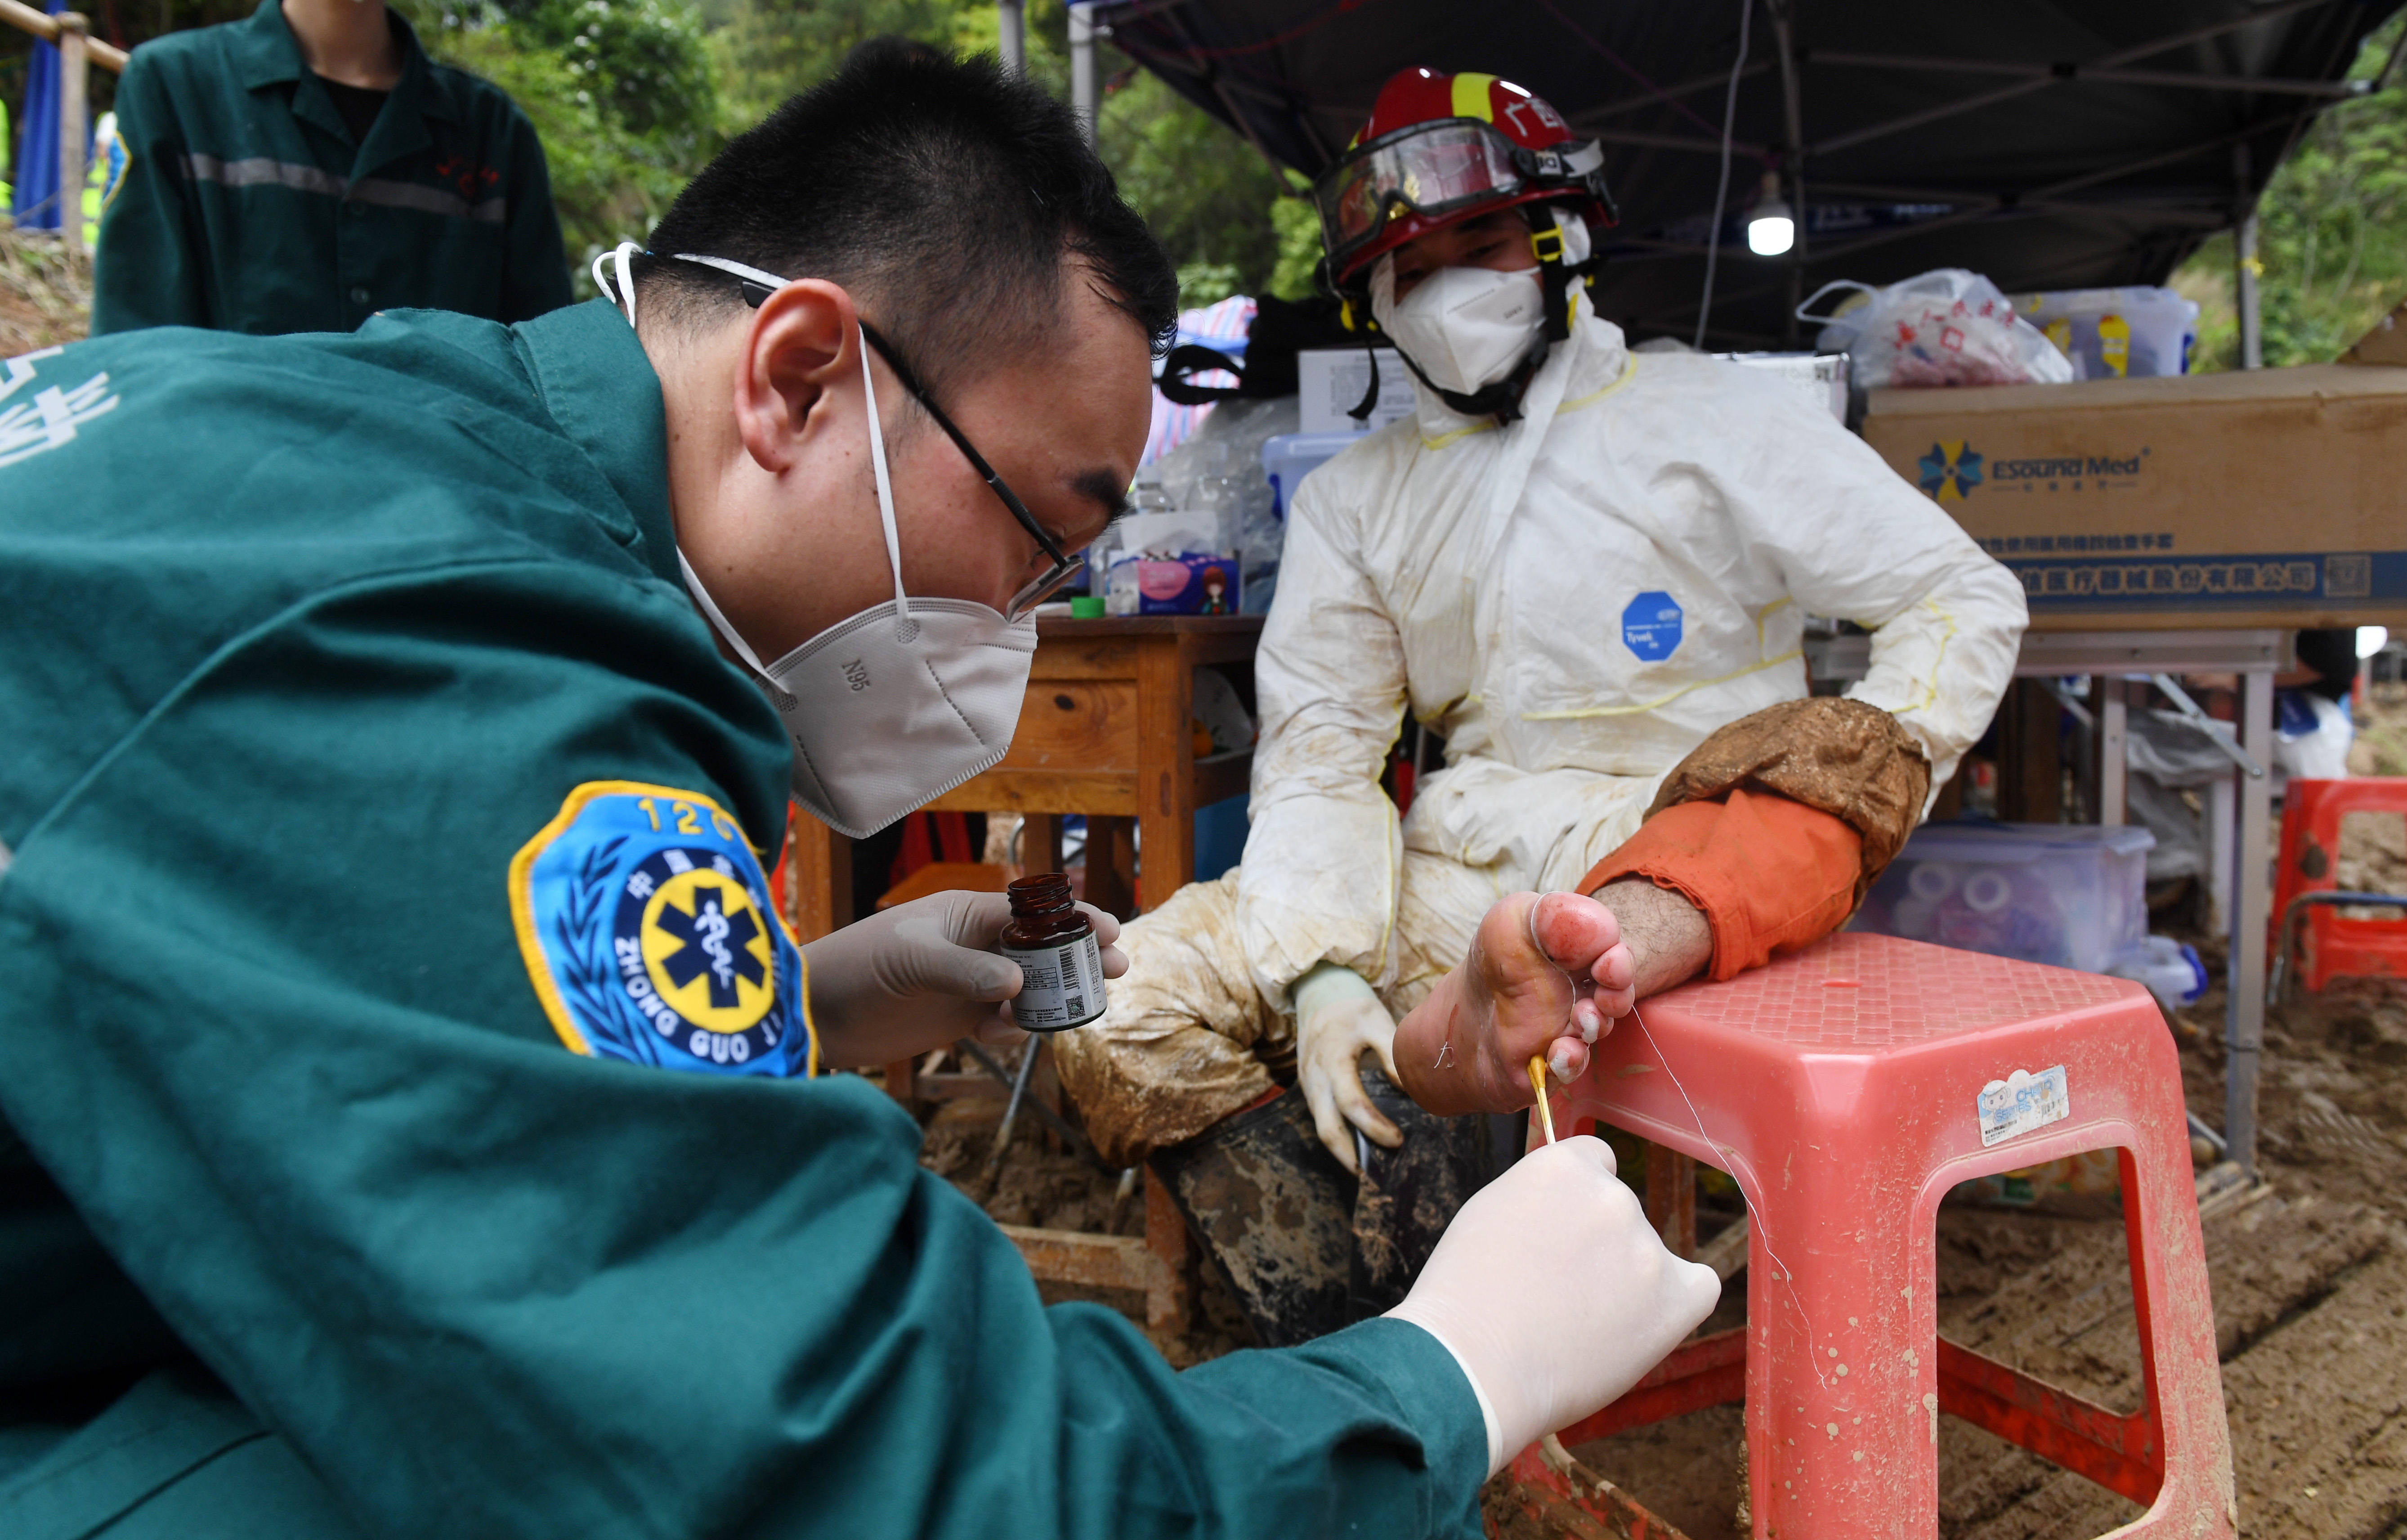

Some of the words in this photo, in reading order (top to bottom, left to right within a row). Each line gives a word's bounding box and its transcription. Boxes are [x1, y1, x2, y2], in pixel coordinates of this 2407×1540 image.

[2087, 455, 2140, 475] Med
[841, 658, 870, 692] N95
[615, 937, 679, 1036] ZHONG
[689, 1029, 750, 1063] GUO
